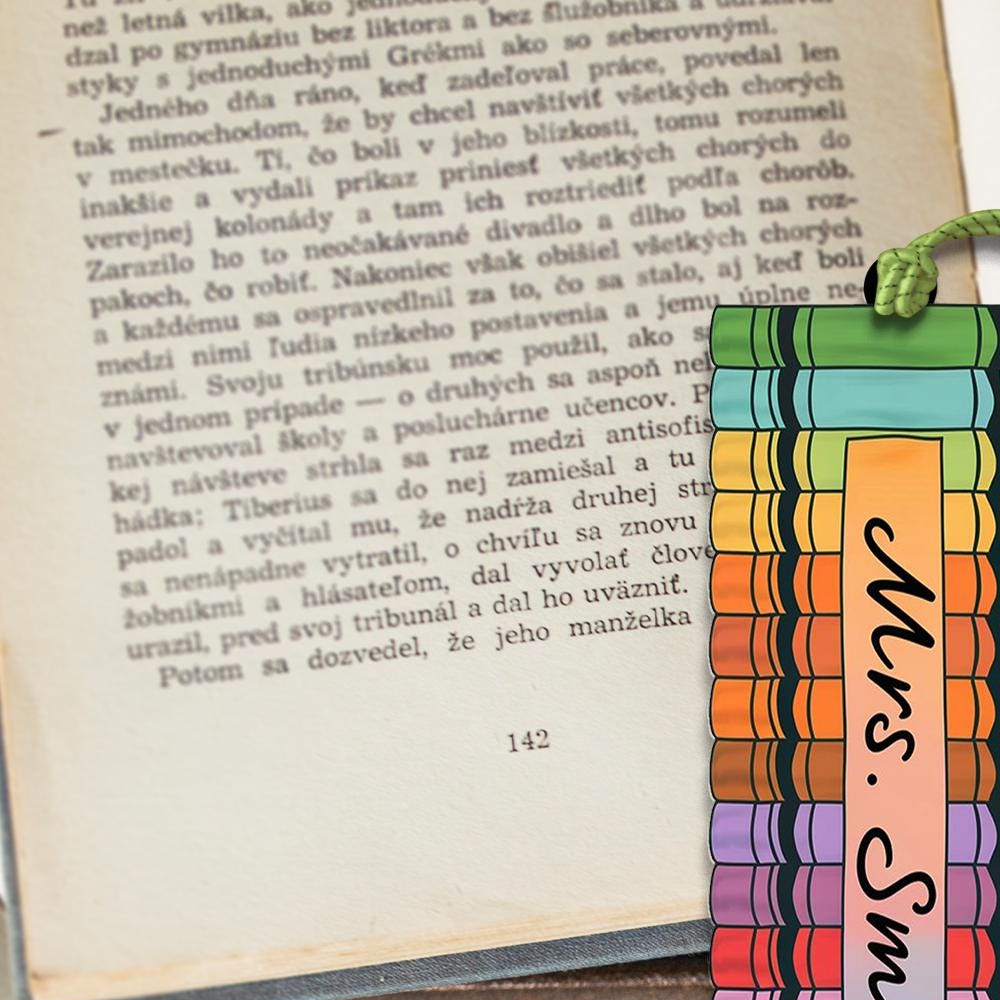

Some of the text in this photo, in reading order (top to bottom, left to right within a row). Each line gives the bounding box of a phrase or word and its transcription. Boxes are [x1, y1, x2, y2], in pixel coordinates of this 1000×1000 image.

[121, 9, 188, 34] letná
[365, 16, 452, 40] liktora
[386, 40, 486, 67] Grékmi
[447, 59, 570, 92] zadeľoval
[408, 98, 476, 126] chcel
[439, 153, 540, 190] priniesť
[695, 131, 800, 160] chorých
[485, 213, 583, 242] divadlo
[759, 216, 863, 246] chorých
[816, 246, 864, 270] boli
[627, 325, 675, 349] ako
[425, 371, 535, 403] druhých
[587, 357, 662, 387] aspoň
[564, 391, 677, 419] učencov.
[449, 443, 491, 464] raz
[509, 427, 586, 456] medzi
[445, 475, 487, 497] nej
[505, 454, 617, 488] zamiešal
[634, 456, 650, 473] a
[667, 449, 696, 469] tu
[465, 481, 657, 524] nadŕža druhej
[475, 526, 560, 555] chvíľu
[575, 525, 603, 543] sa
[619, 514, 699, 538] znovu
[470, 561, 512, 587] dal
[531, 547, 631, 583] vyvolať
[289, 619, 342, 641] svoj
[352, 599, 458, 633] tribunál
[467, 602, 483, 619] a
[492, 590, 532, 615] dal
[540, 588, 574, 609] ho
[307, 635, 428, 671] dozvedel,
[447, 631, 476, 653] že
[495, 622, 551, 652] jeho
[568, 606, 693, 638] manželka
[863, 516, 937, 787] Mrs.
[507, 729, 550, 753] 142
